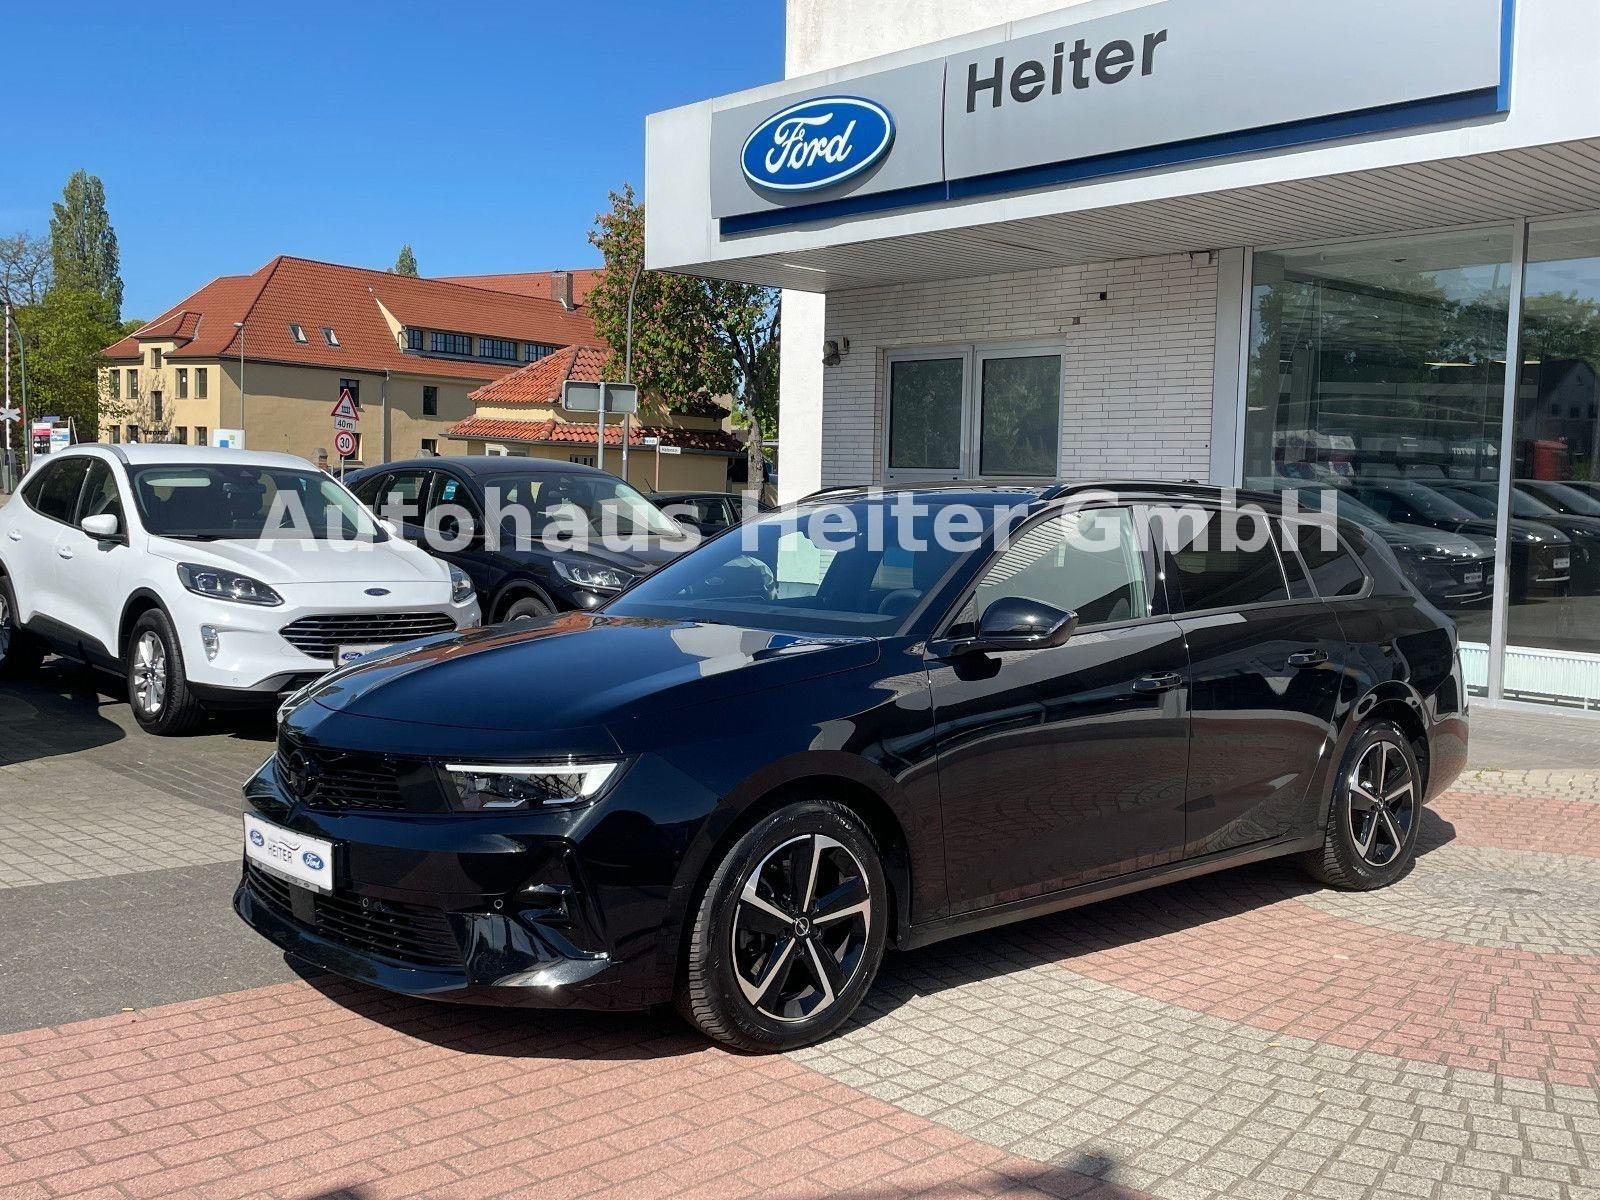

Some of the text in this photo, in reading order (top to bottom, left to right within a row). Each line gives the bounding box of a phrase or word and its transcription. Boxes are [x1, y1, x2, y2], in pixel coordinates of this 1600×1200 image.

[965, 29, 1168, 113] Heiter
[765, 112, 856, 174] Ford
[340, 437, 350, 448] 30
[268, 841, 293, 864] HEITER
